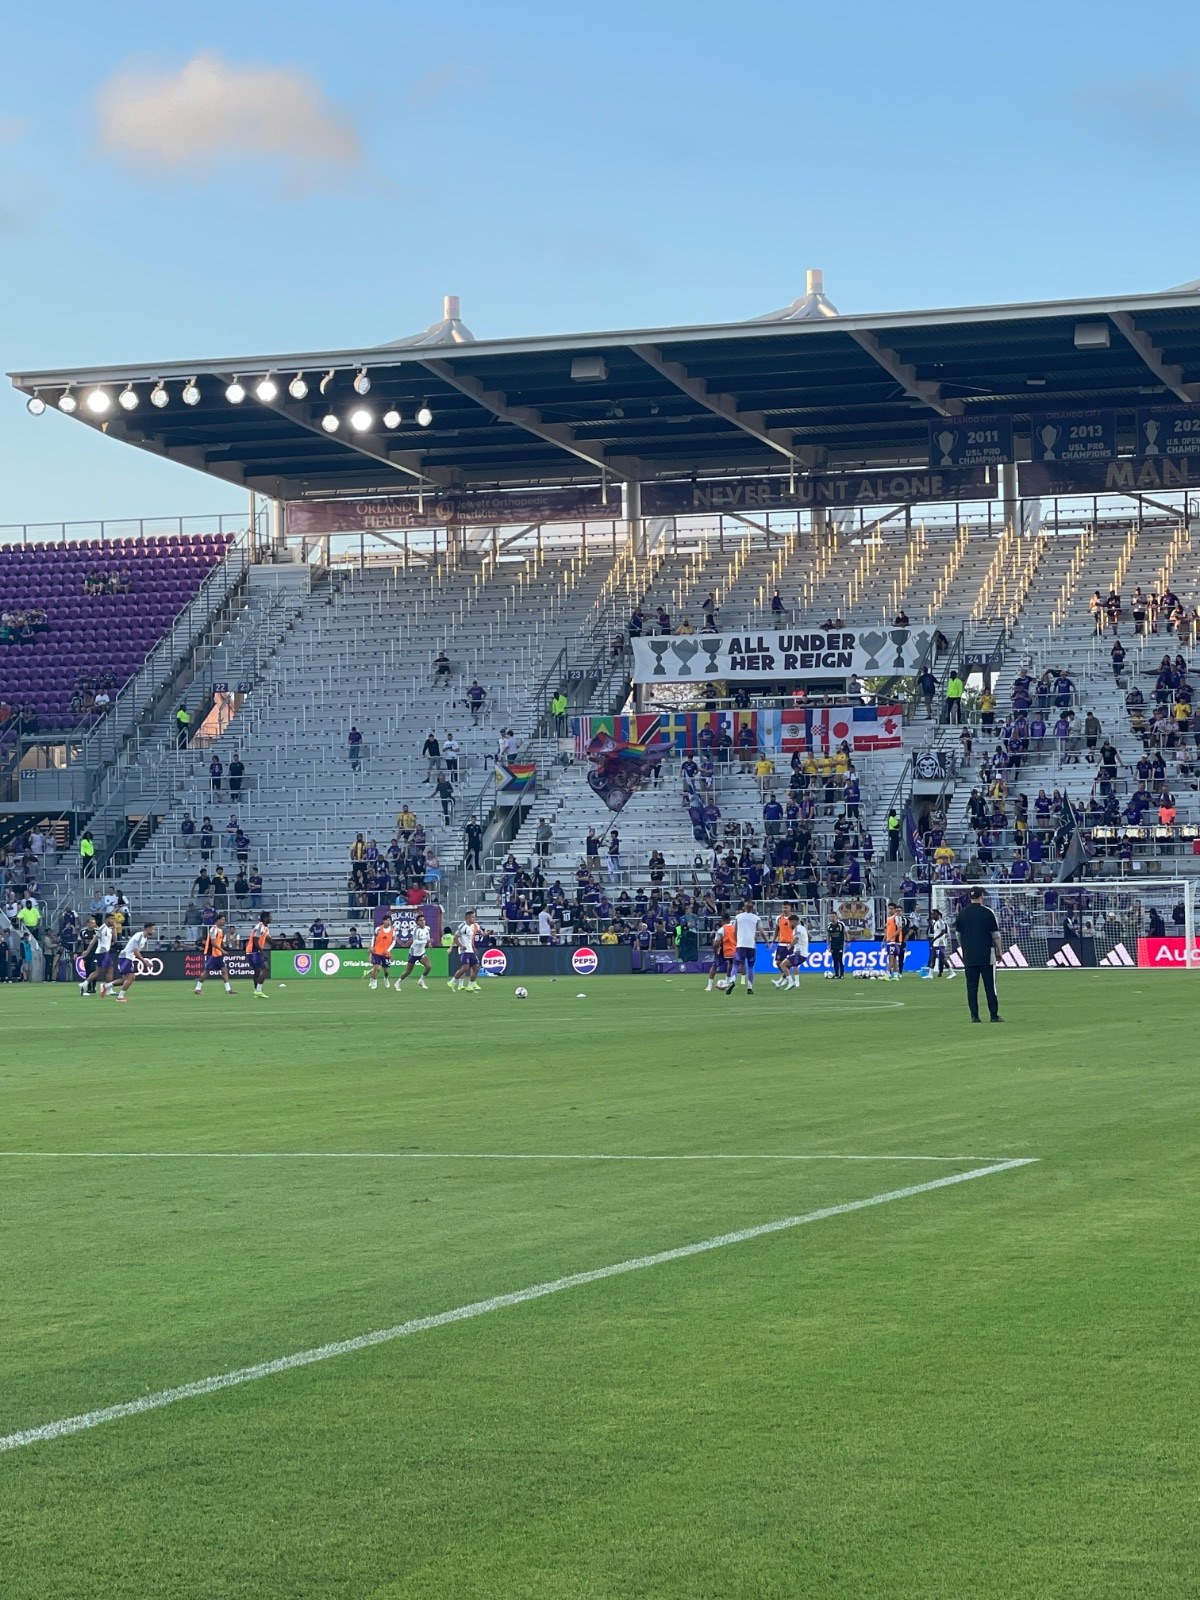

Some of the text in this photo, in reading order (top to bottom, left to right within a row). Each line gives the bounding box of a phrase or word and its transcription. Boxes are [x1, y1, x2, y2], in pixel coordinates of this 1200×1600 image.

[1174, 419, 1200, 432] 202
[967, 430, 999, 444] 2011
[1070, 425, 1103, 438] 2013
[965, 447, 1000, 457] USL PRO
[1068, 442, 1104, 451] USL PRO
[959, 454, 1009, 465] CHAMPIONS
[1061, 449, 1112, 459] CHAMPIONS
[1105, 457, 1189, 489] MAN
[693, 484, 772, 506] NEVER
[856, 475, 943, 499] ALONE
[457, 497, 549, 509] Jewett Orthopedic
[457, 510, 498, 520] Institute
[364, 515, 416, 528] HEALTH
[728, 633, 857, 655] ALL UNDER
[730, 651, 853, 671] HER REIGN
[968, 655, 979, 664] 24
[570, 670, 581, 679] 23
[215, 683, 226, 692] 22
[22, 769, 35, 779] 122
[483, 958, 505, 966] PEPSI
